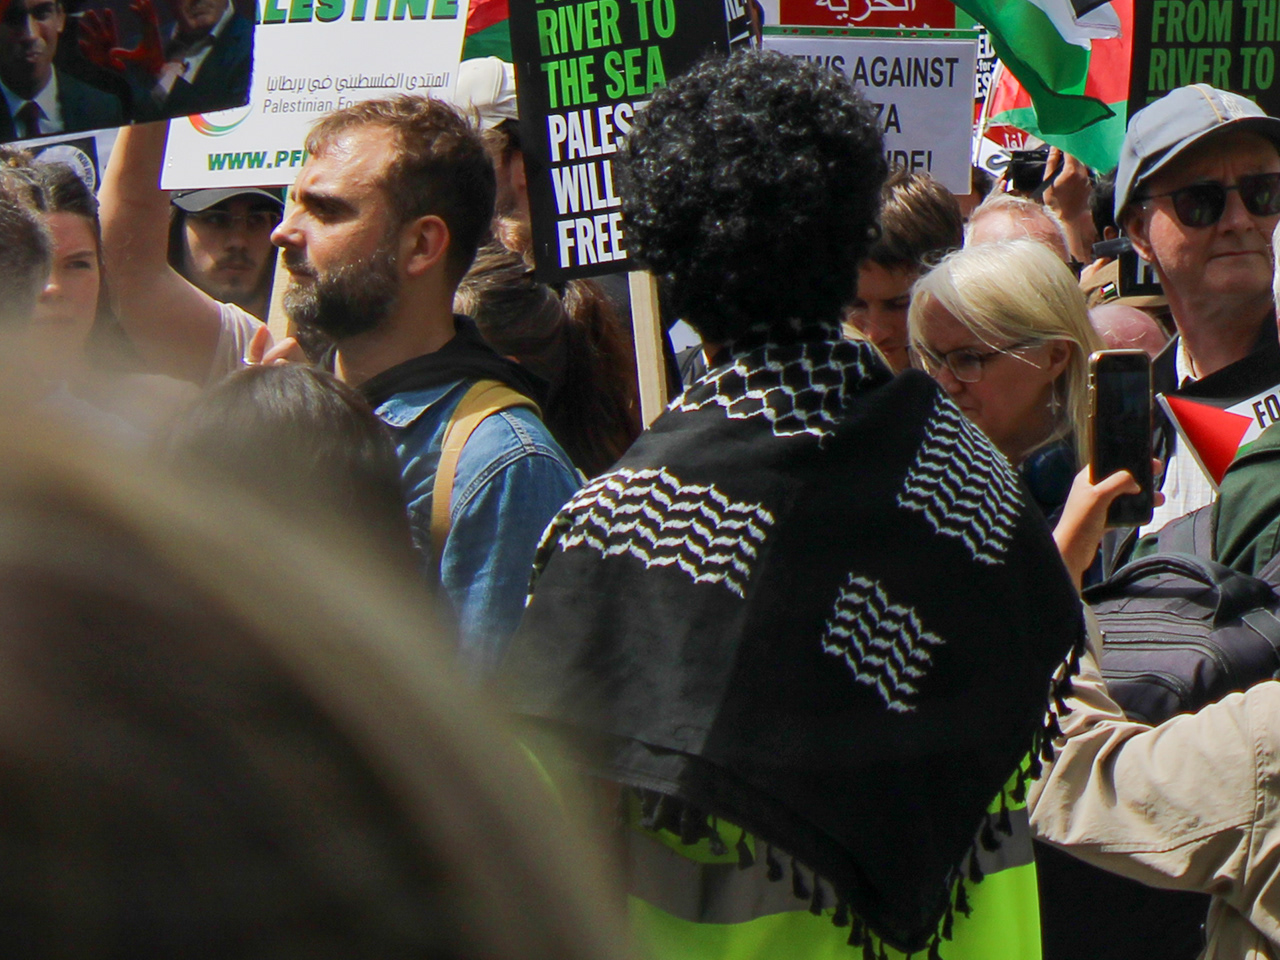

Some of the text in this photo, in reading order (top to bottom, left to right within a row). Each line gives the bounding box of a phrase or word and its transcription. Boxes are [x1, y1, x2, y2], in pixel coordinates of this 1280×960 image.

[1151, 0, 1233, 43] FROM
[540, 45, 667, 108] THE SEA
[853, 56, 959, 88] AGAINST
[1150, 46, 1275, 91] RIVER TO
[262, 96, 332, 114] Palestinian
[547, 100, 651, 162] PALES
[550, 160, 622, 215] WILL
[556, 212, 628, 268] FREE
